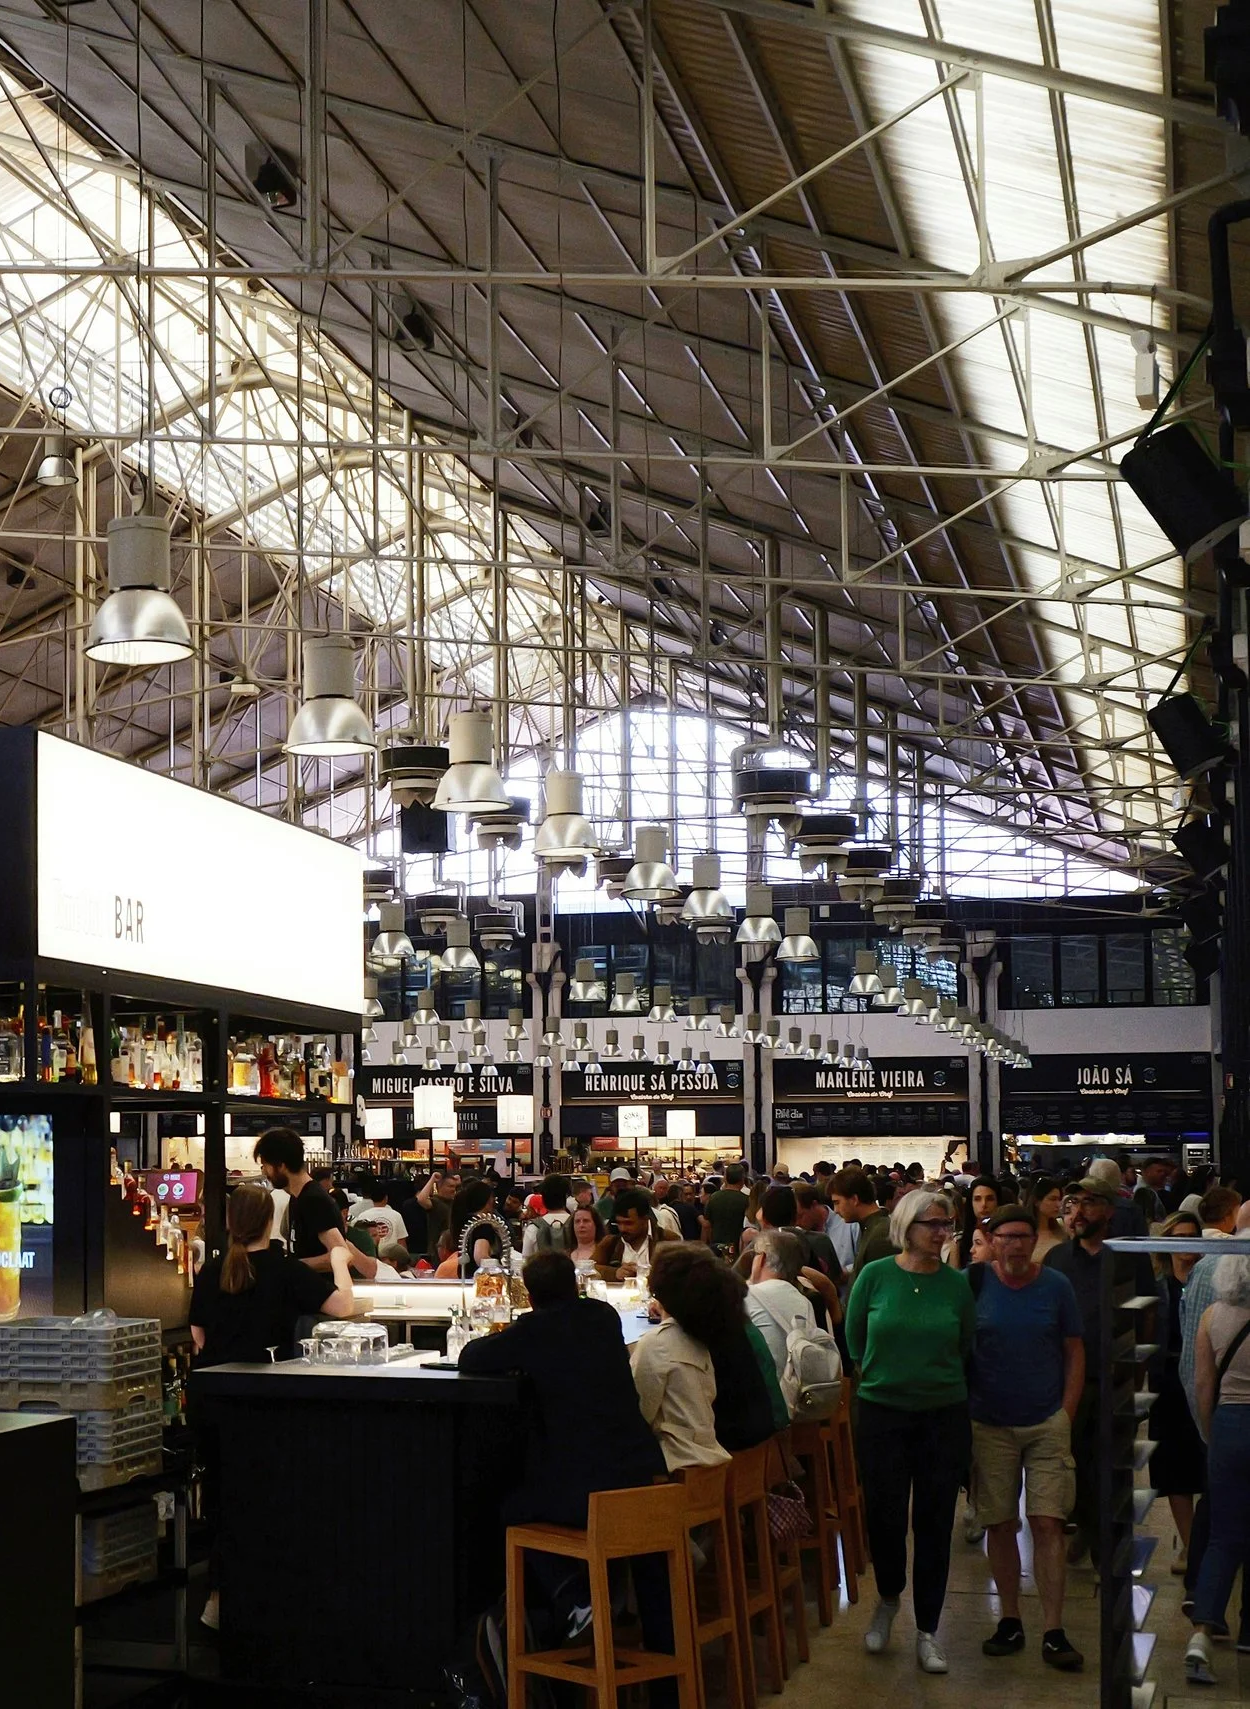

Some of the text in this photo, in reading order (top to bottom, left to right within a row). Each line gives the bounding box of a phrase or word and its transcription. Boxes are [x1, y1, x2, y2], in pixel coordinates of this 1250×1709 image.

[114, 894, 144, 944] BAR
[585, 1073, 645, 1092] HENRIQUE
[650, 1071, 666, 1091] SÁ
[671, 1072, 719, 1091] PESSOA
[816, 1071, 876, 1089] MARLENE
[880, 1070, 924, 1088] VIEIRA
[1077, 1064, 1110, 1085] JOÃO
[1115, 1063, 1133, 1084] SÁ
[372, 1077, 414, 1094] MIGUEL
[469, 1076, 475, 1093] E
[479, 1076, 514, 1093] SILVA
